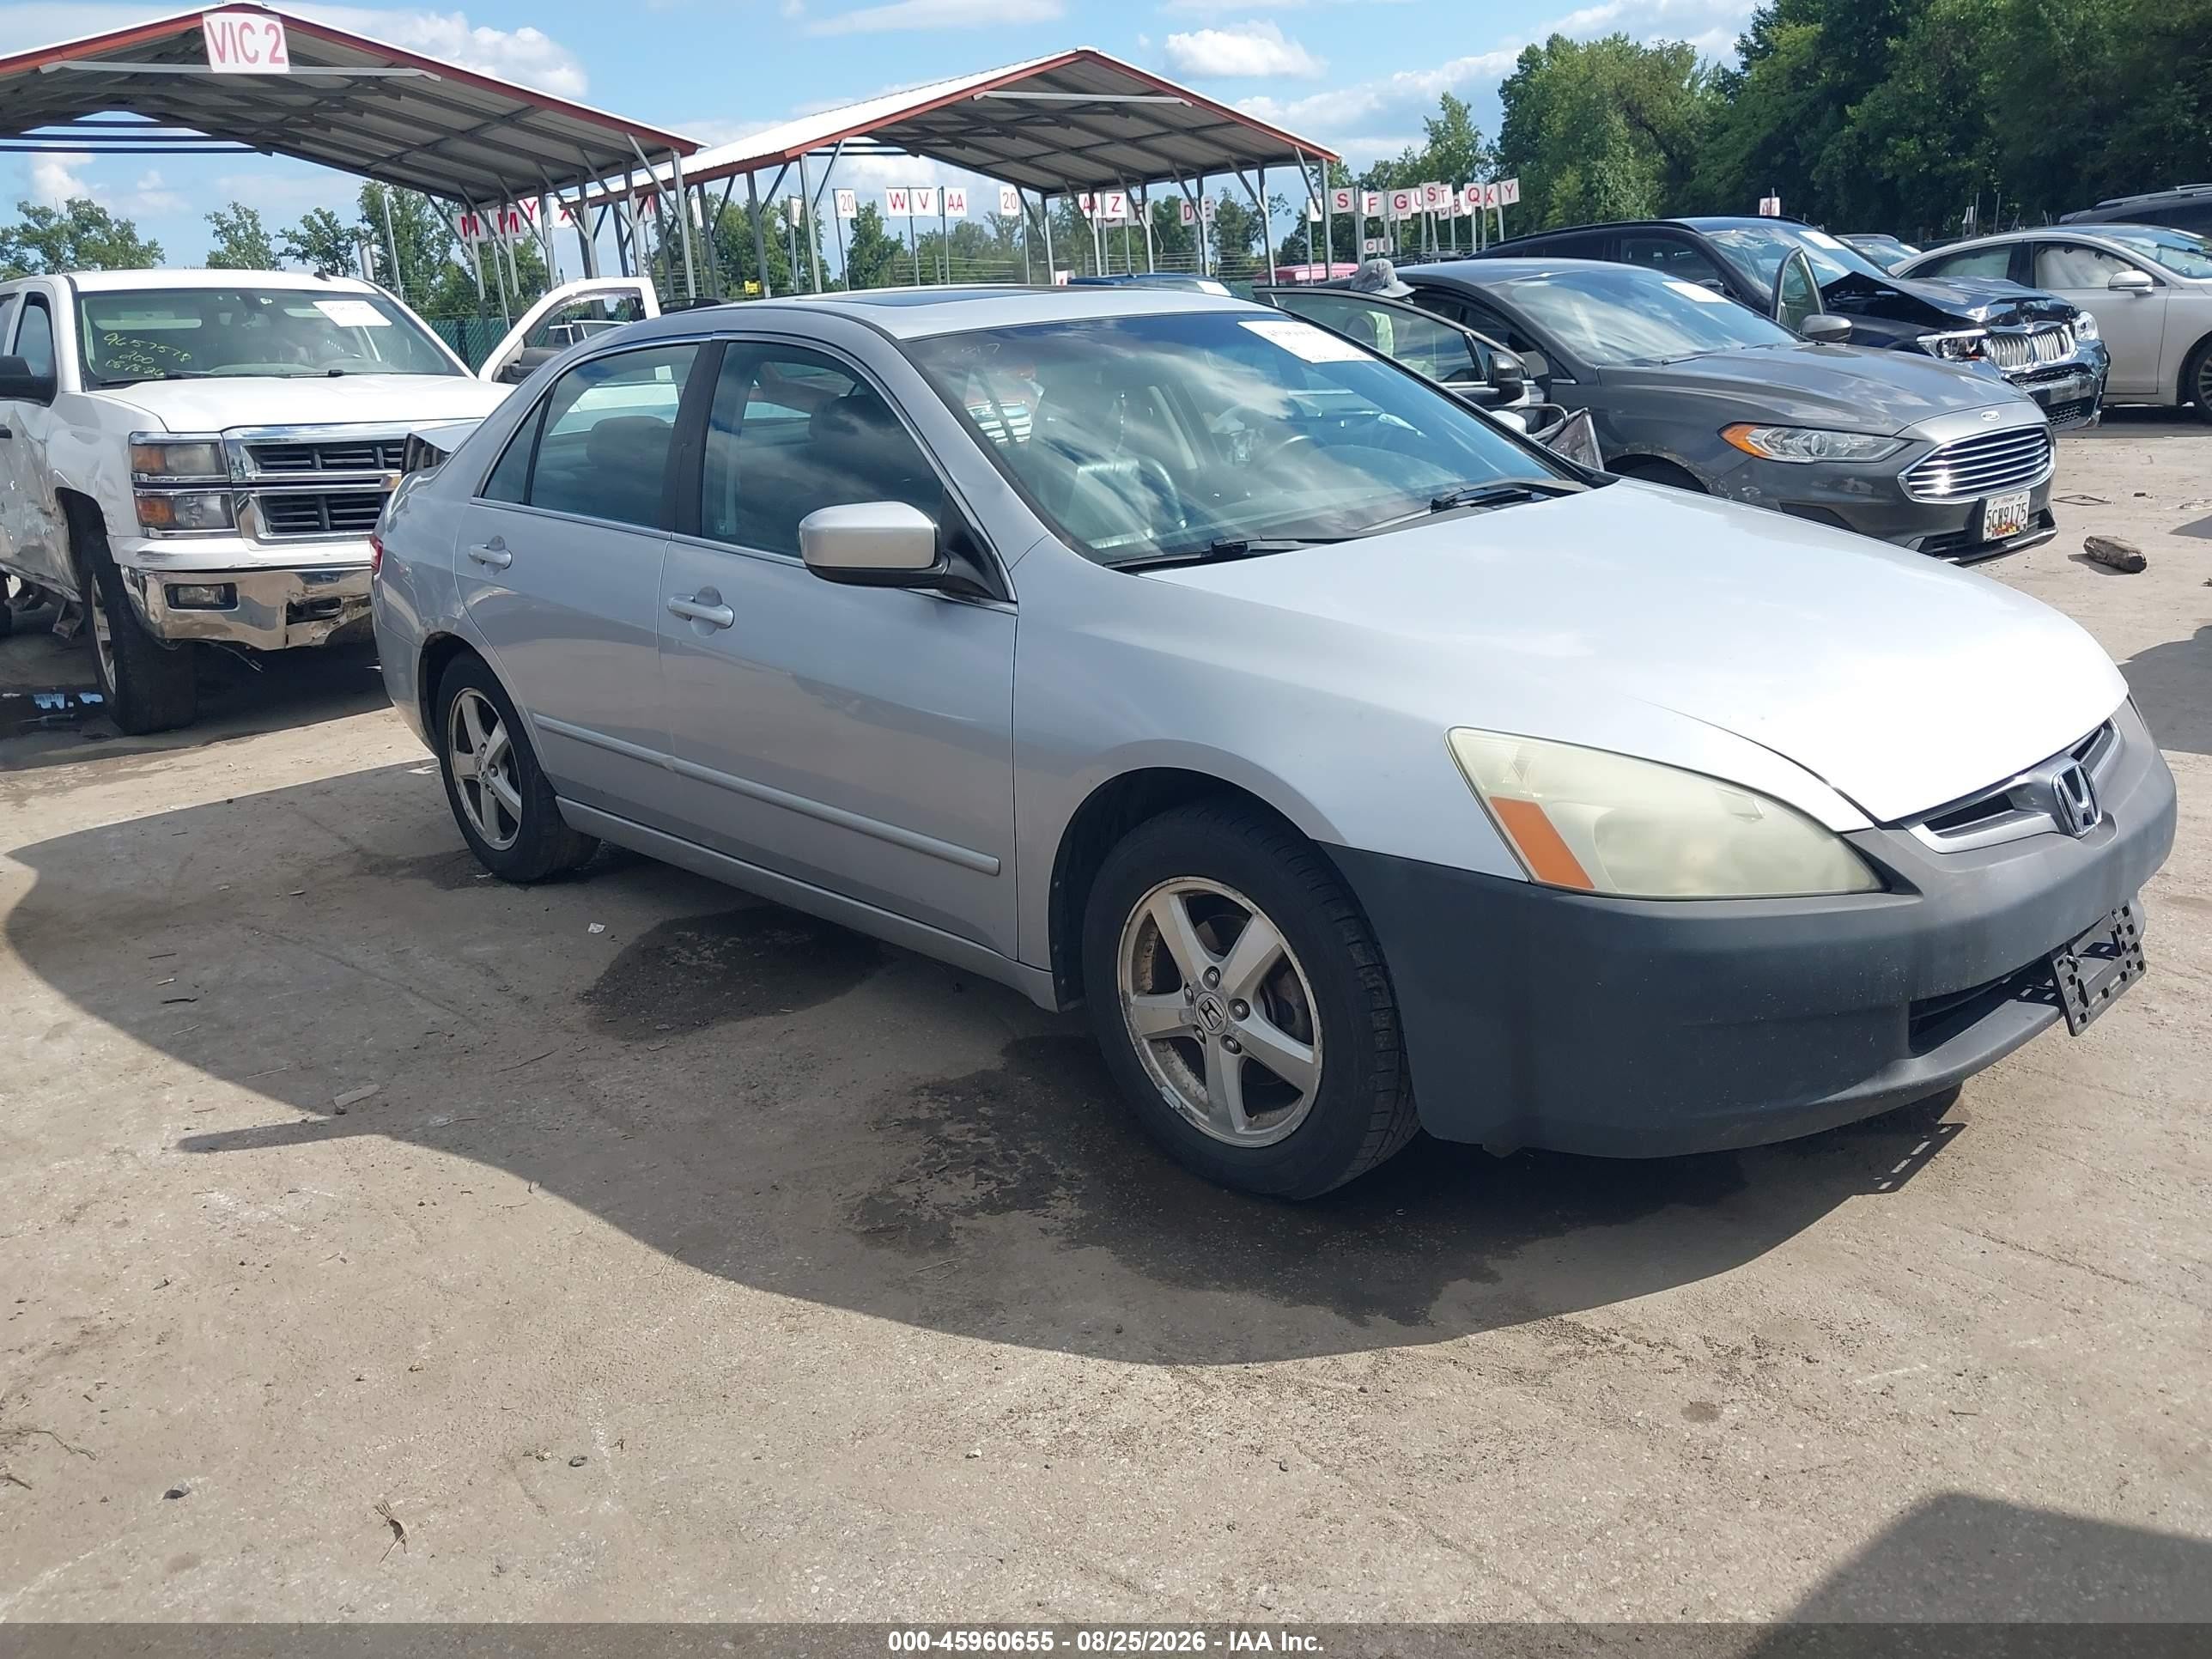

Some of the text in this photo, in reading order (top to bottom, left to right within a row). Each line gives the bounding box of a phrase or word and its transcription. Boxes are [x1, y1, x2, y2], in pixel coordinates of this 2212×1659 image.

[206, 21, 286, 64] VIC 2
[1427, 186, 1437, 202] S
[1438, 189, 1447, 204] T
[1468, 187, 1480, 203] Q
[1504, 183, 1514, 199] Y
[840, 193, 854, 213] 20
[889, 191, 906, 211] W
[917, 191, 929, 210] V
[947, 193, 965, 212] AA
[1002, 191, 1018, 210] 20
[1110, 195, 1121, 213] Z
[1337, 193, 1348, 209] S
[1368, 197, 1377, 213] F
[1394, 194, 1407, 210] G
[522, 199, 538, 221] Y
[1183, 204, 1193, 221] D
